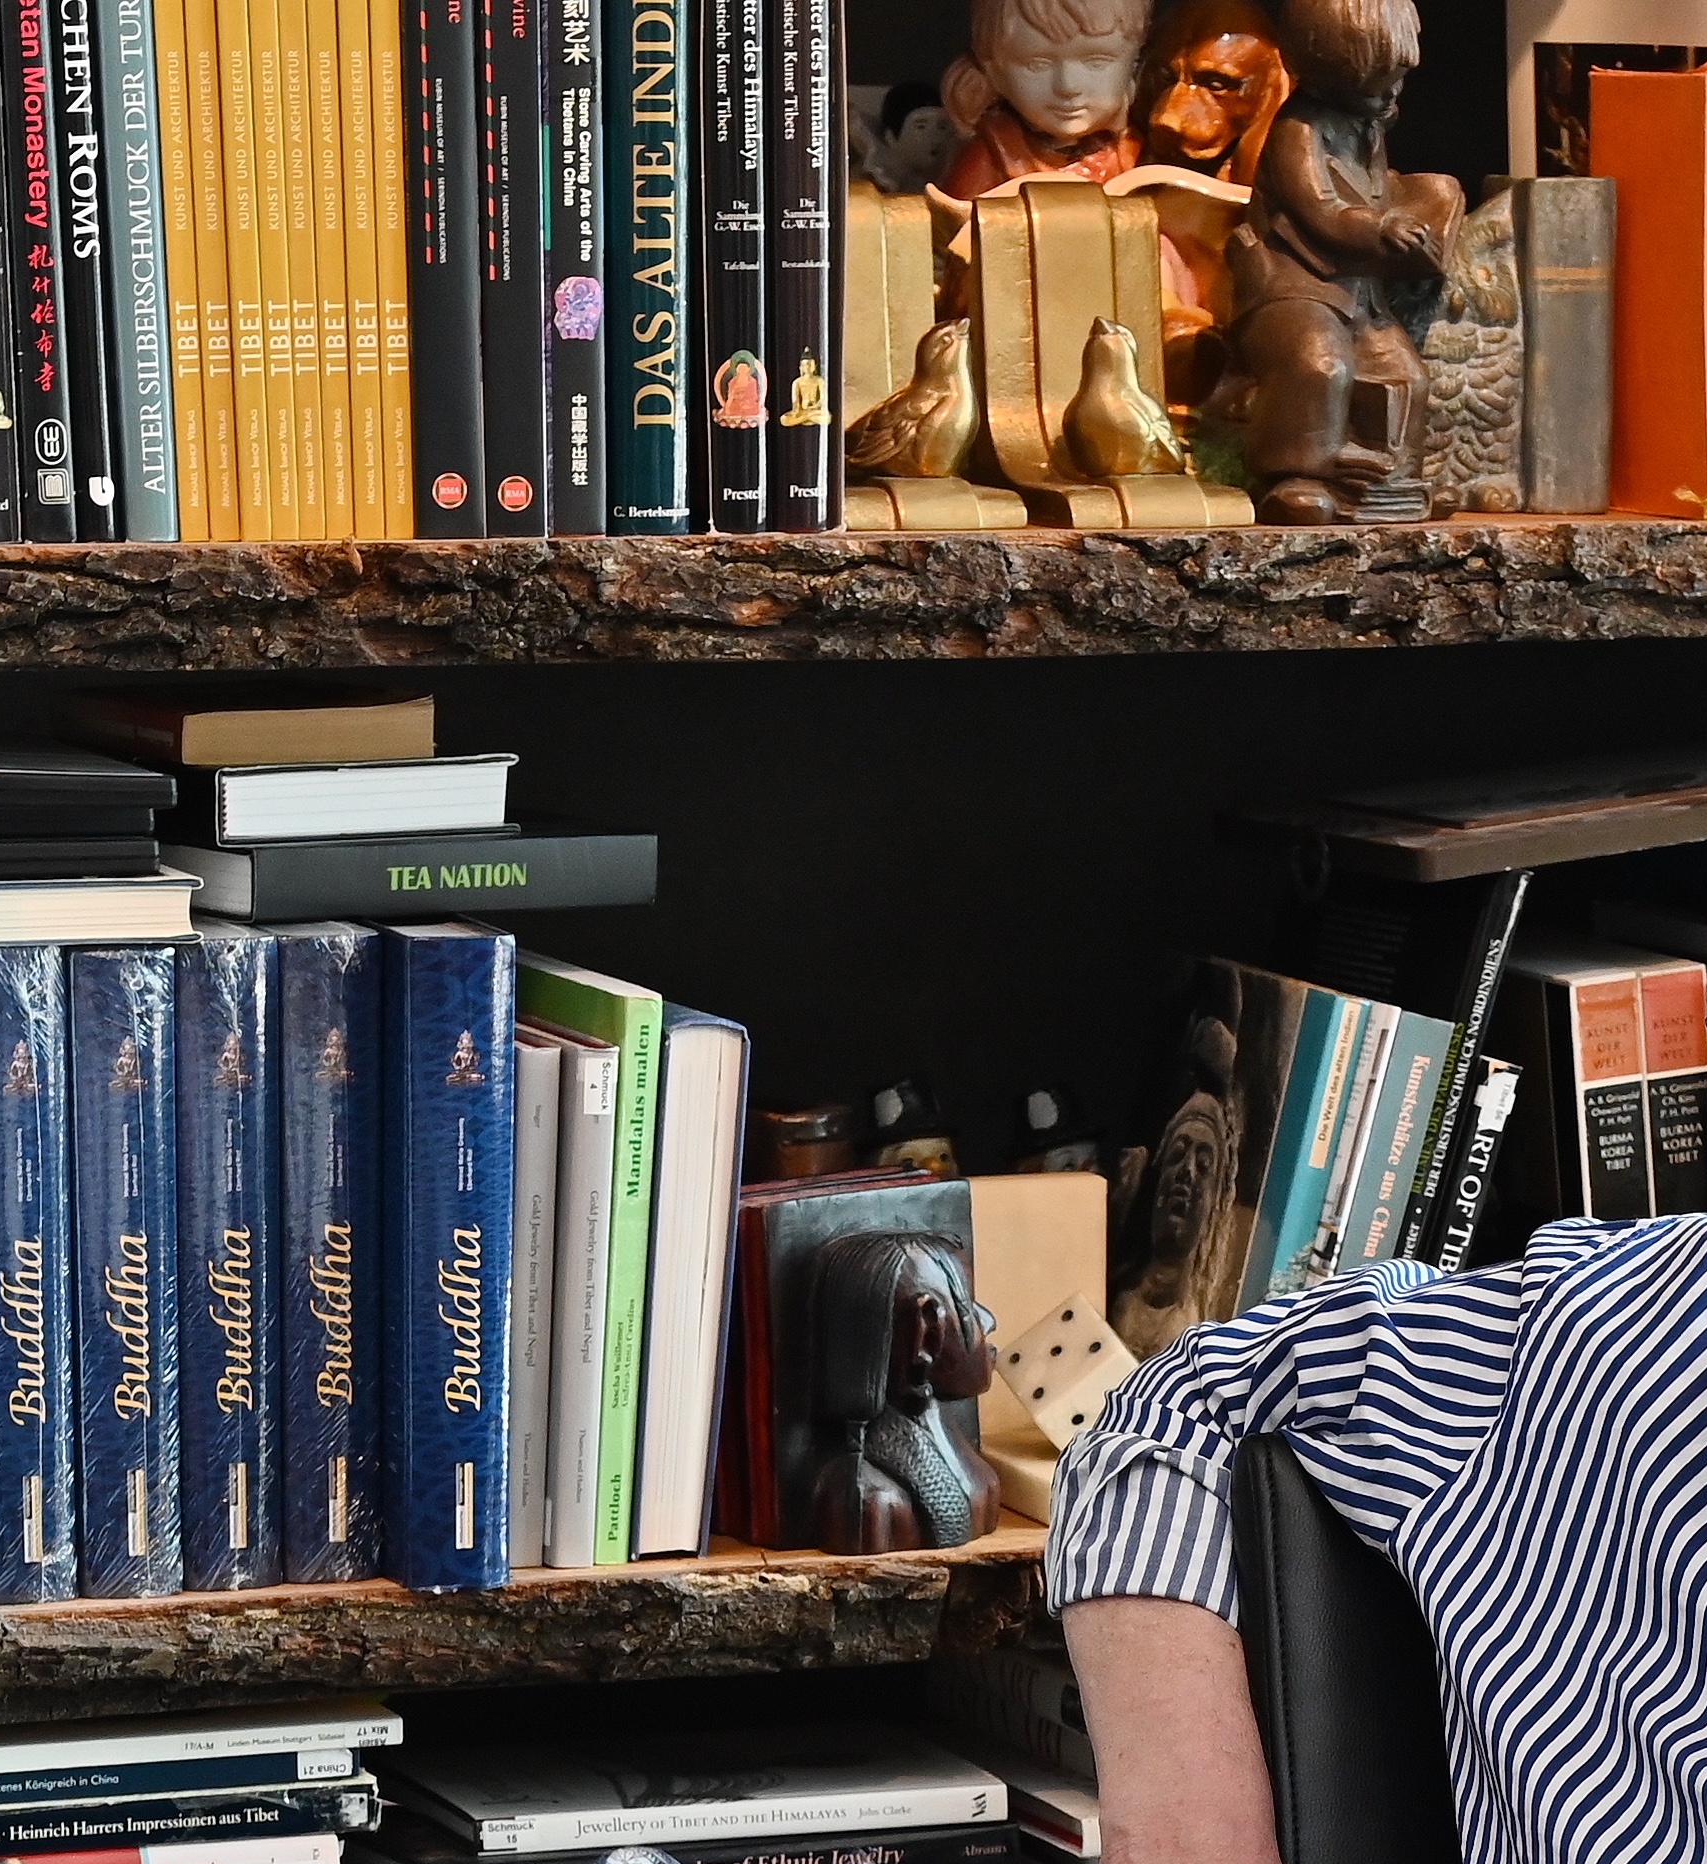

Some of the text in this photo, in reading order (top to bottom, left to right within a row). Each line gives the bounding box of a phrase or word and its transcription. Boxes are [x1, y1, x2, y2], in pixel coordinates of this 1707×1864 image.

[22, 66, 51, 229] Monastery
[231, 49, 250, 230] KUNST UND ARCHITEKTUR
[562, 88, 576, 207] Tibetans China
[577, 87, 593, 262] Stone Carving Arts of the
[67, 131, 101, 260] ROMS
[122, 69, 166, 495] ALTER SILBERSCHMUCK DER
[633, 141, 676, 430] DAS ALTE
[176, 301, 200, 378] TIBET
[238, 300, 263, 377] TIBET
[293, 299, 316, 377] TIBET
[355, 299, 378, 376] TIBET
[386, 300, 409, 377] TIBET
[571, 393, 588, 486] 中国藏学出版社
[386, 863, 527, 891] TEA NATION
[602, 1061, 611, 1110] Schmuck
[1423, 938, 1501, 1199] DER FÜRSTENSCHMUCK NORDINDIENS
[627, 1024, 650, 1198] Mandalas malen
[1659, 1122, 1703, 1138] BURMA
[1662, 1137, 1703, 1151] KOREA
[1364, 1055, 1433, 1258] Kunstschätze aus China
[1668, 1151, 1698, 1165] TIBET
[105, 1229, 150, 1421] Buddha
[208, 1224, 252, 1415] Buddha
[438, 1223, 481, 1413] Buddha
[608, 1473, 621, 1542] Pattloch
[25, 1776, 76, 1792] Königreich
[78, 1776, 88, 1787] in
[90, 1774, 119, 1786] China
[9, 1823, 70, 1842] Heinrich
[72, 1819, 124, 1836] Harrers
[126, 1813, 216, 1834] Impressionen
[218, 1811, 241, 1826] aus
[243, 1807, 279, 1824] Tibet
[487, 1821, 535, 1833] Schmuck
[506, 1835, 518, 1844] 15
[575, 1817, 647, 1839] Jewellery
